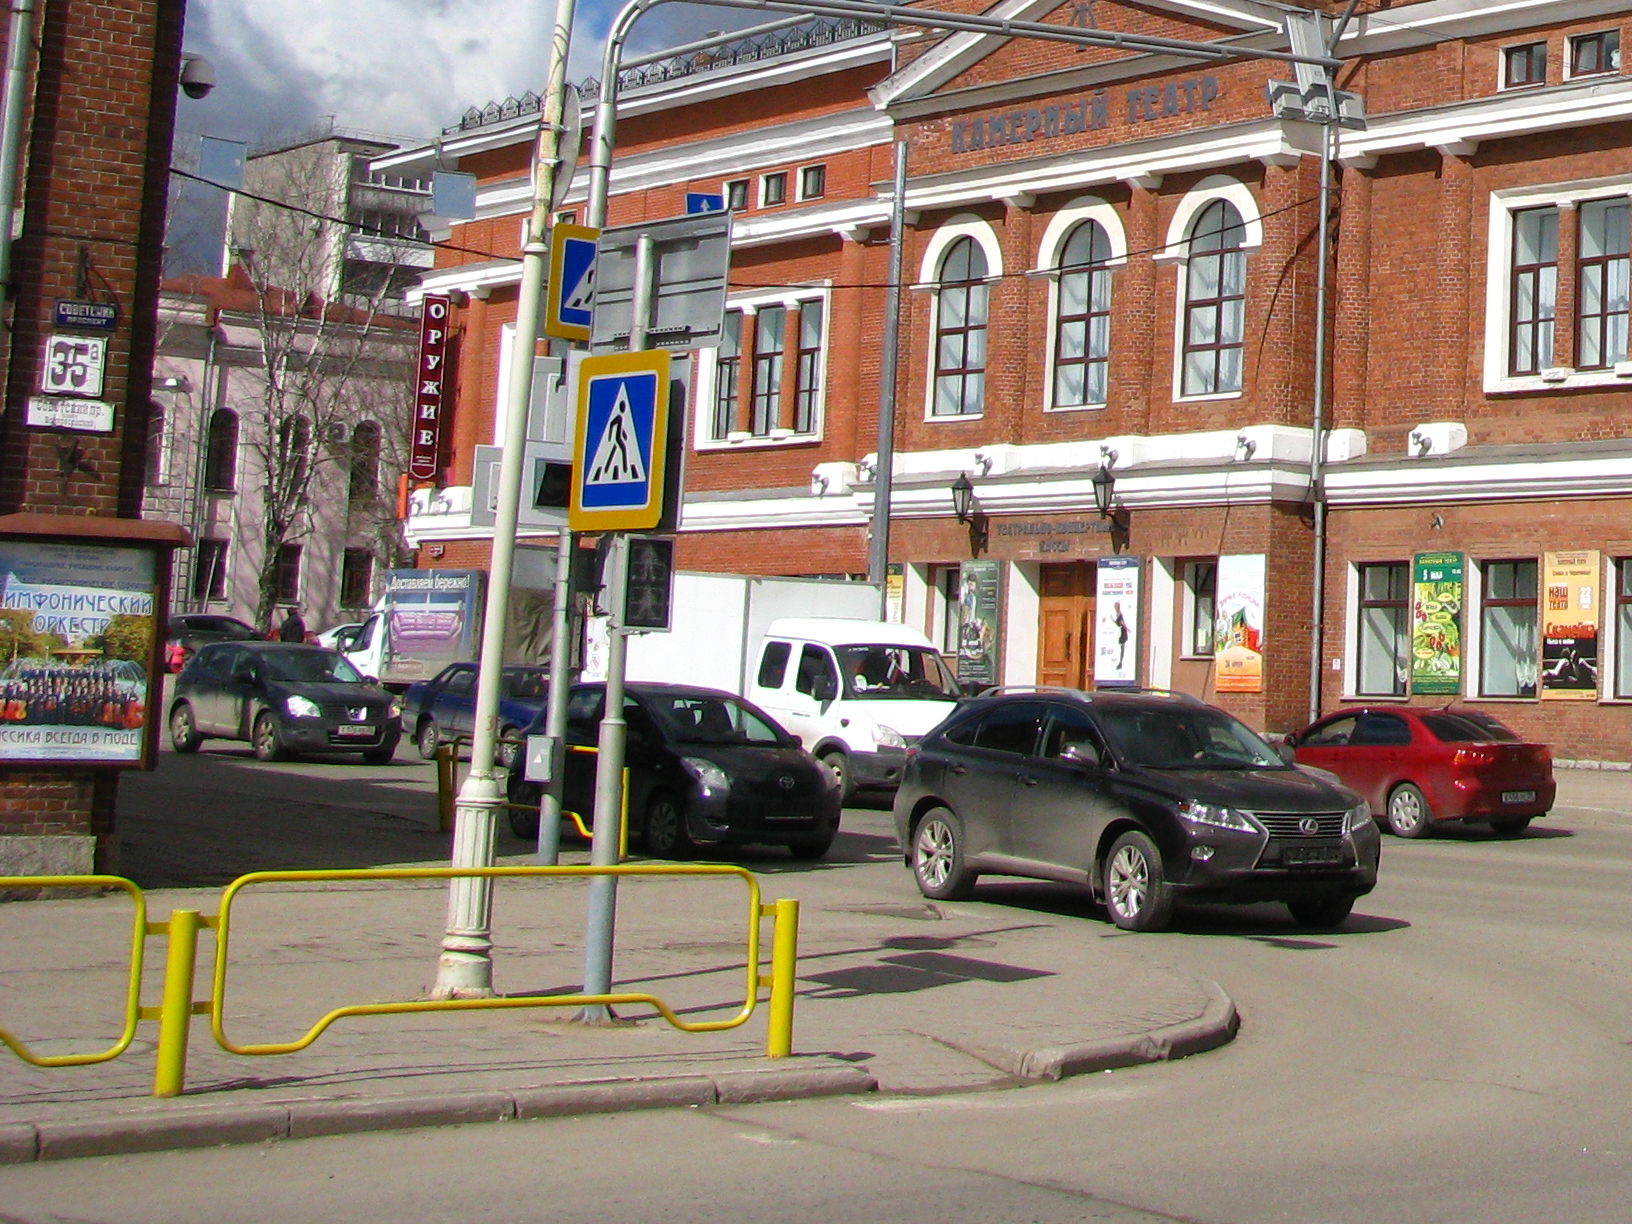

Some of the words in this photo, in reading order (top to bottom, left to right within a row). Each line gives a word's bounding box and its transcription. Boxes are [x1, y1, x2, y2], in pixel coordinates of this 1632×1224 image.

[952, 88, 1109, 154] КАМЕРНЫЙ
[1126, 77, 1218, 123] ТЕАТР
[418, 303, 446, 445] ОРУЖИЕ
[3, 591, 152, 614] ИМФОНИЧЕСКИЙ
[34, 615, 110, 634] ОРКЕСТР
[0, 730, 41, 743] ССИКА
[45, 730, 87, 744] ВСЕГДА
[91, 732, 100, 744] В
[103, 733, 138, 746] МОДЕ
